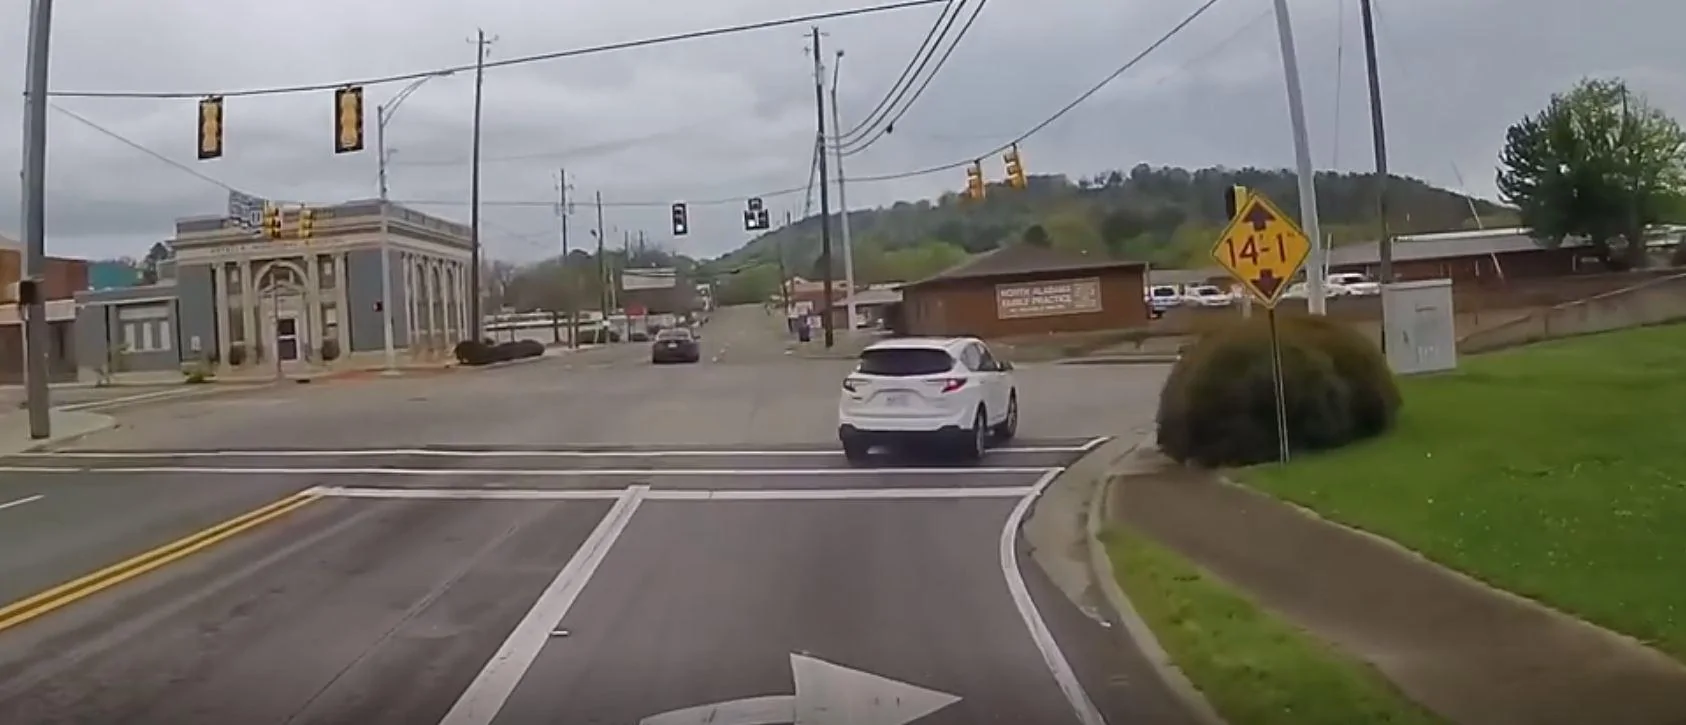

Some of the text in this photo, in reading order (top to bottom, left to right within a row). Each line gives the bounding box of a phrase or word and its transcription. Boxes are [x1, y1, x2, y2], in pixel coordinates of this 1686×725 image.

[1000, 284, 1072, 297] NORTH ALABAMA
[1032, 294, 1073, 304] PRACTICE
